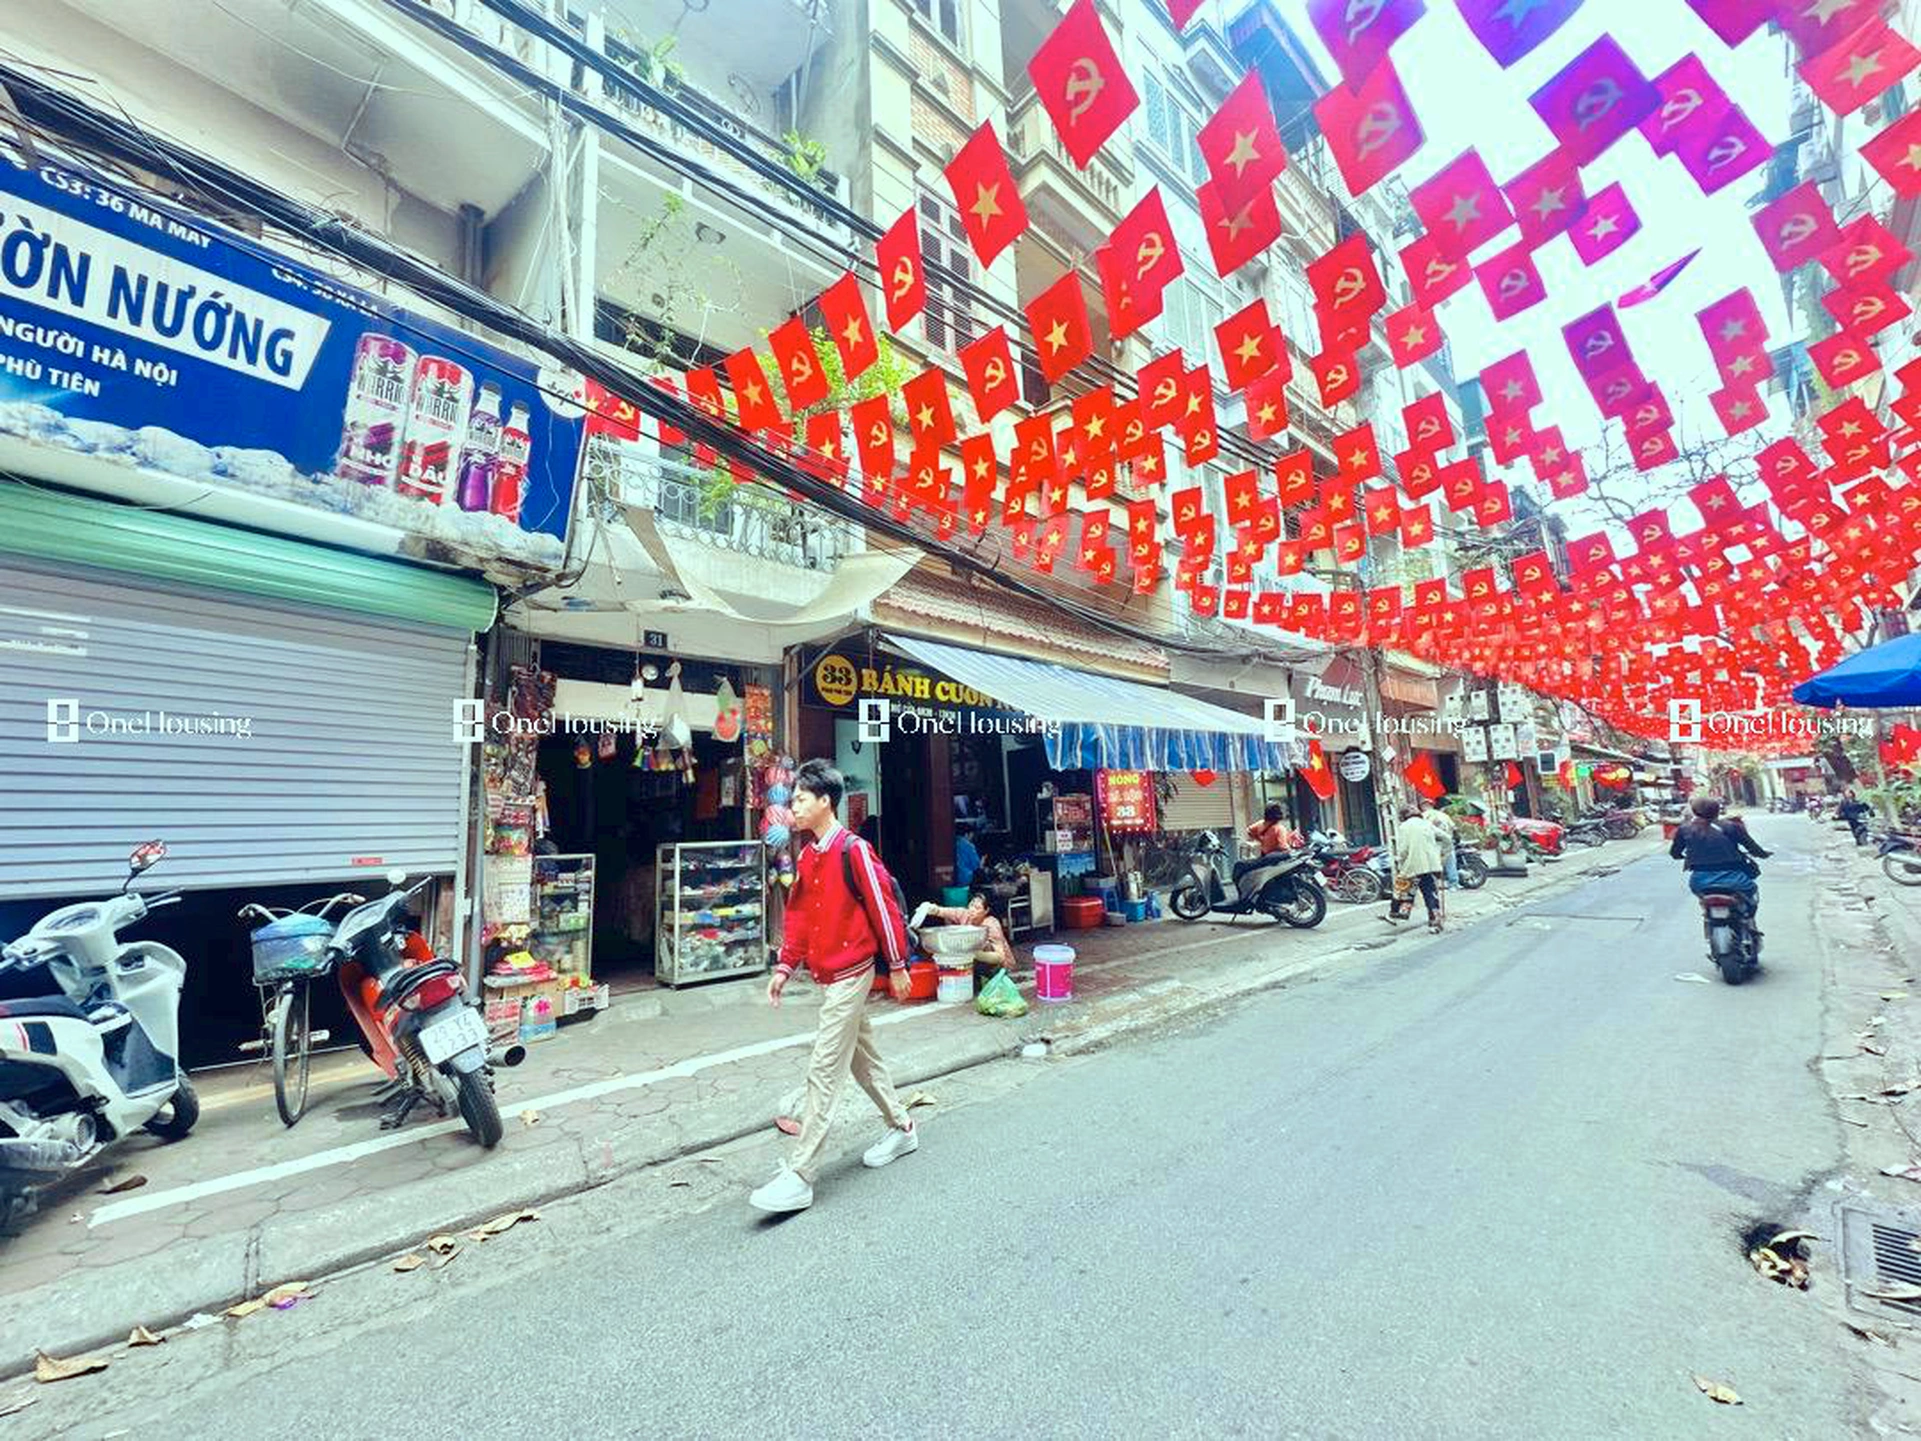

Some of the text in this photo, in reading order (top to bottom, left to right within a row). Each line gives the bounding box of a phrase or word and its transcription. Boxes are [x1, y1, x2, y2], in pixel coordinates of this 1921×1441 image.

[40, 166, 93, 200] CS3:
[95, 187, 125, 213] 36
[0, 211, 296, 377] ỜN NƯỚNG
[0, 314, 178, 387] NGƯỜI HÀ NỘI
[48, 367, 101, 397] TIÊN
[649, 632, 663, 647] 31
[822, 664, 853, 687] 33
[860, 664, 932, 700] BÁNH
